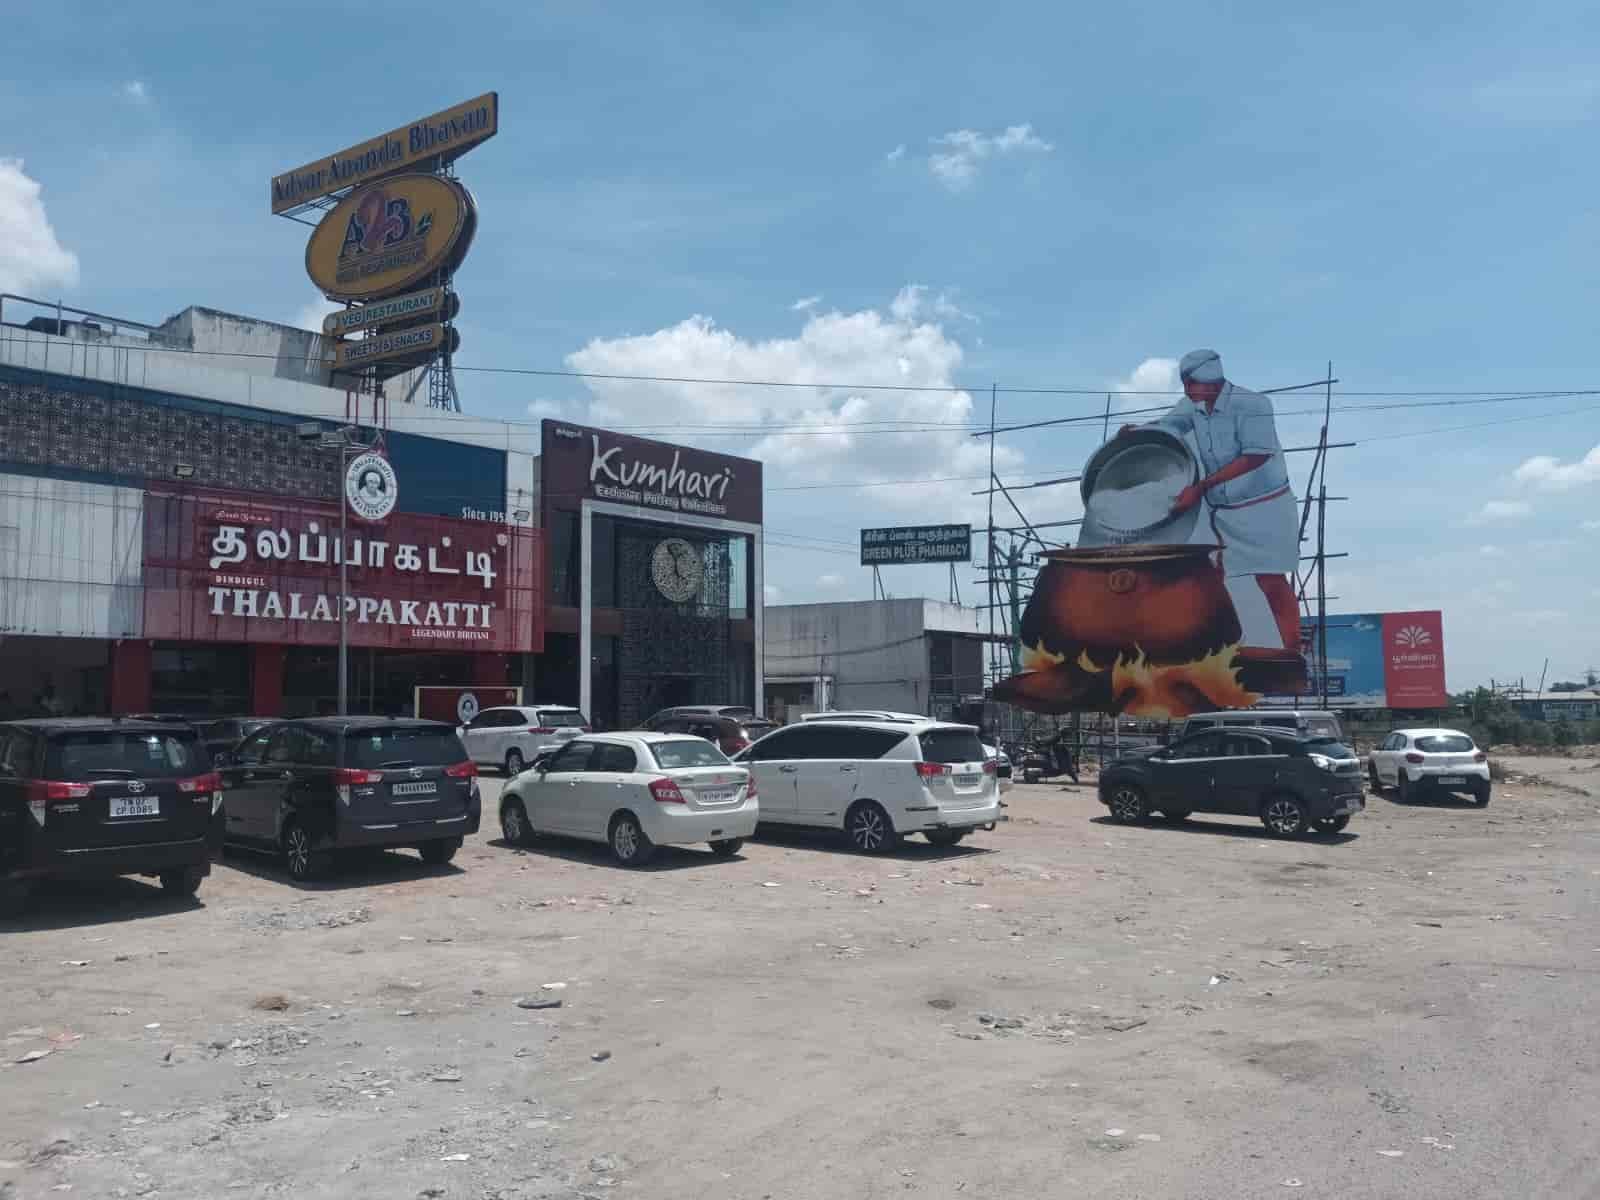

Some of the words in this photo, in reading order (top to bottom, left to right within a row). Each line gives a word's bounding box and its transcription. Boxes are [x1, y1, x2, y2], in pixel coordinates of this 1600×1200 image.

[329, 135, 401, 178] Ananda
[408, 106, 488, 151] Bhavan
[341, 312, 362, 327] VEG
[365, 294, 434, 321] RESTAURANT
[393, 328, 433, 350] SNACKS
[590, 434, 730, 499] Kumhari
[462, 506, 486, 520] Since
[894, 544, 918, 560] PLUS
[918, 542, 969, 559] PHARMACY
[215, 574, 266, 587] DINDIGUL
[207, 586, 492, 629] THALAPPAKATTI
[411, 628, 457, 640] LEGENDARY
